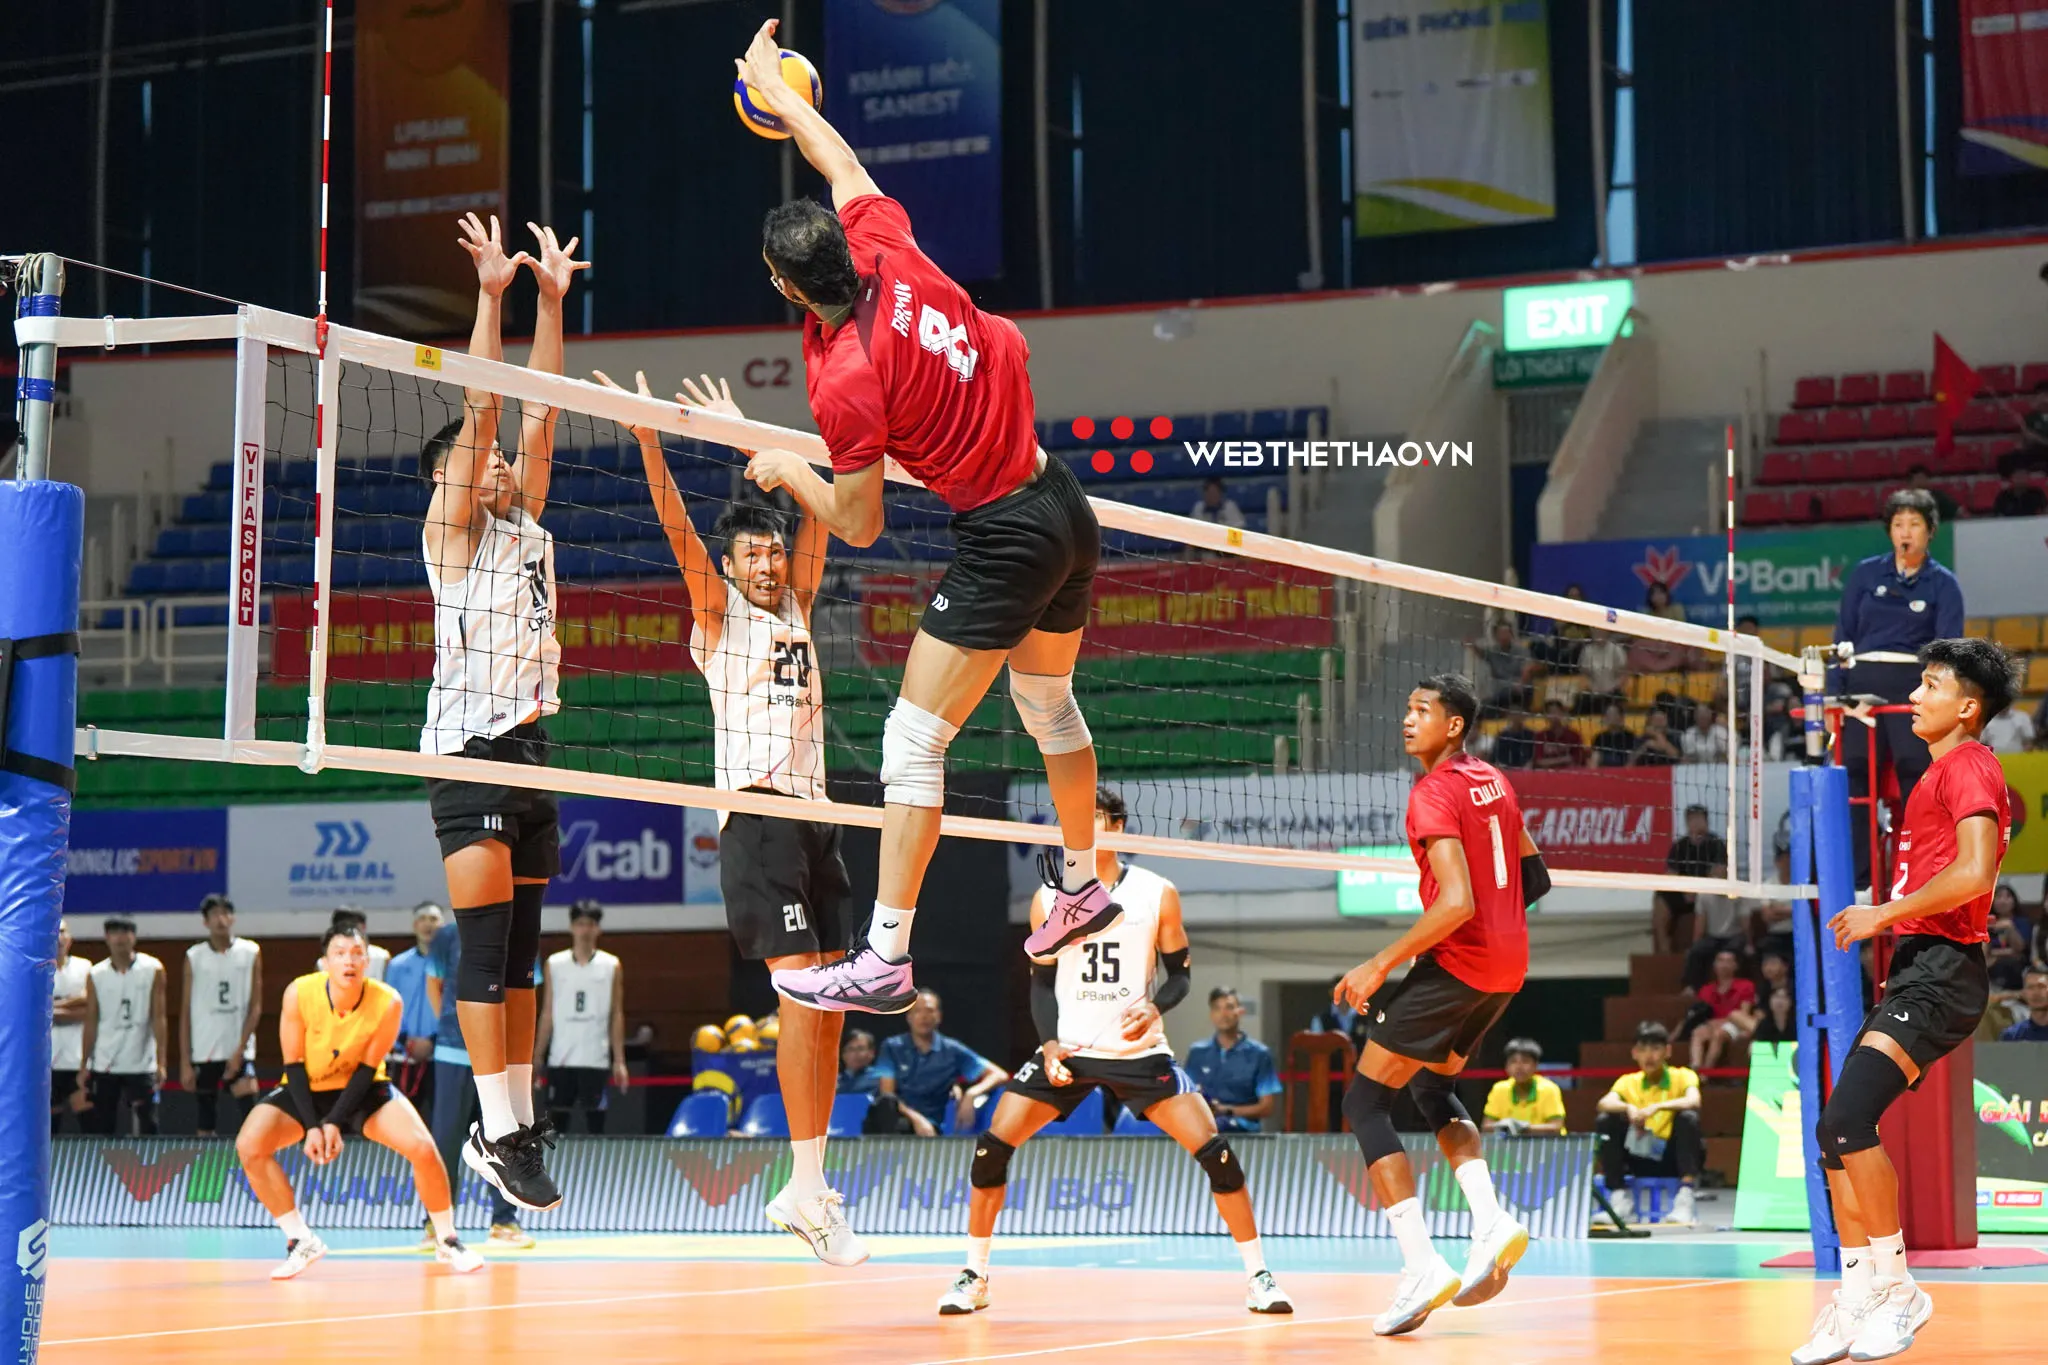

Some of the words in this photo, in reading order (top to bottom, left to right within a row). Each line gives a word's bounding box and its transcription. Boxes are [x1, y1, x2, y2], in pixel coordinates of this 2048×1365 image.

[1526, 294, 1609, 340] EXIT
[919, 304, 979, 382] 8
[742, 358, 792, 387] C2
[241, 450, 257, 622] VIFASPORT
[1697, 557, 1844, 596] VPBank
[773, 641, 810, 688] 20
[1488, 814, 1509, 889] 1
[288, 861, 396, 885] BULBAL
[1891, 862, 1909, 901] 2
[783, 903, 808, 933] 20
[1082, 942, 1120, 983] 35
[218, 981, 230, 1005] 2
[575, 990, 586, 1013] 8
[1076, 989, 1118, 1002] LPBank
[18, 1283, 36, 1365] SPORT
